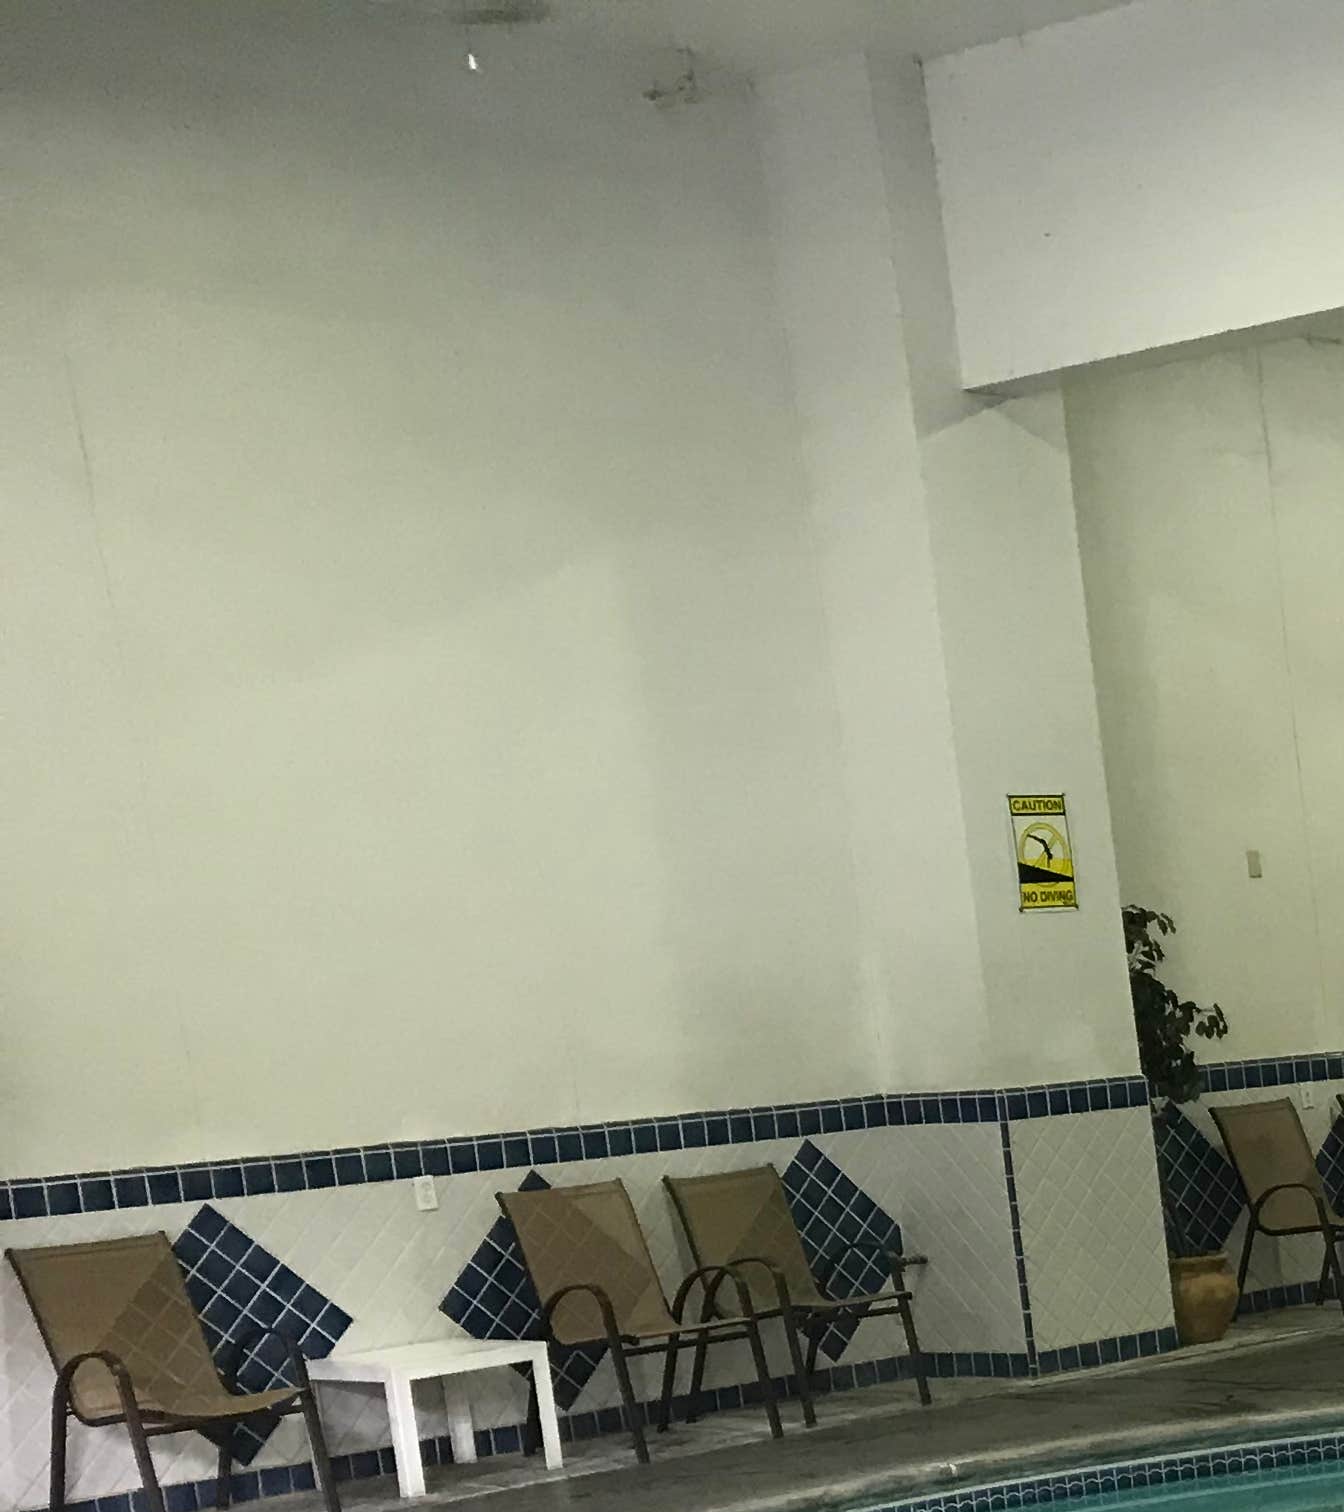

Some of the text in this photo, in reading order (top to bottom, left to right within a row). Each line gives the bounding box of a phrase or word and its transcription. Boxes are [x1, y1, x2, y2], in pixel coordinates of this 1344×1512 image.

[1012, 799, 1062, 810] CAUTION
[1023, 889, 1074, 903] NO DIVING
